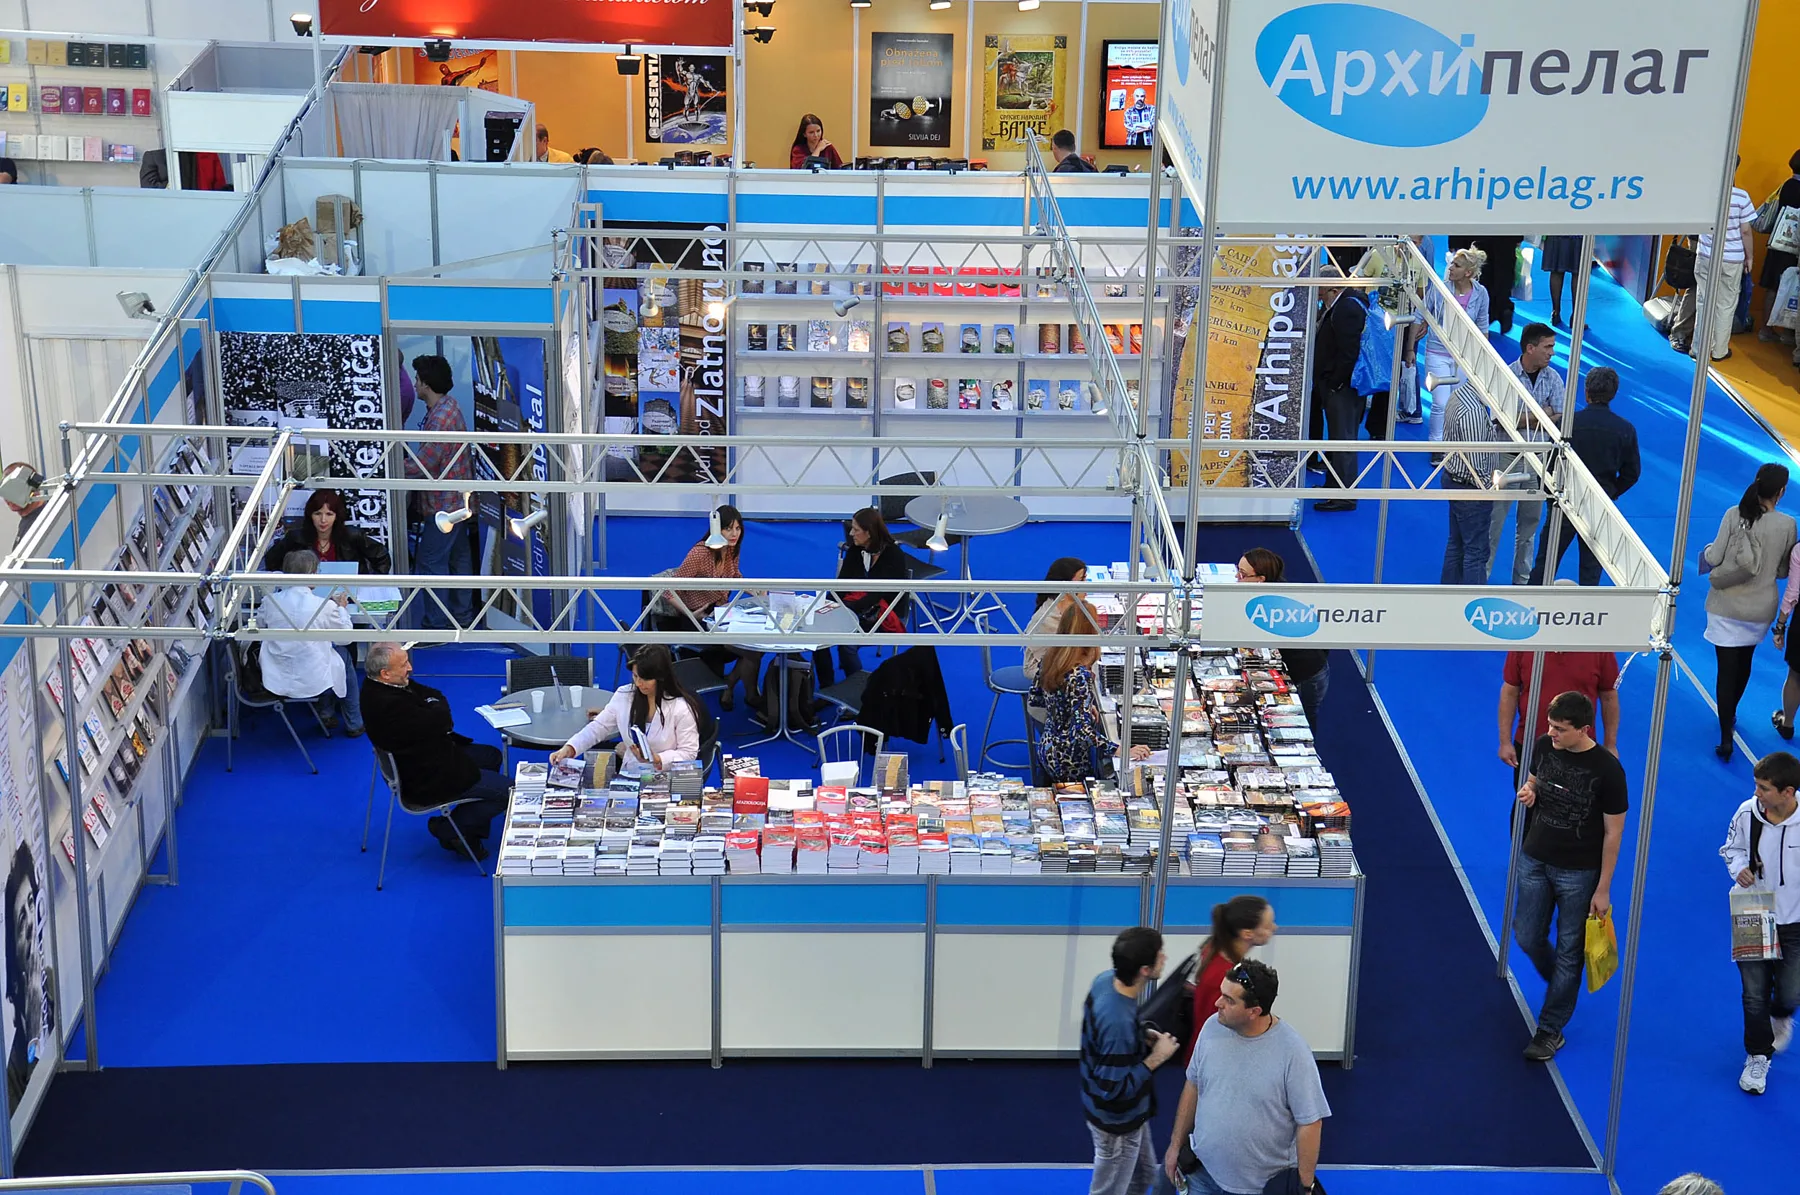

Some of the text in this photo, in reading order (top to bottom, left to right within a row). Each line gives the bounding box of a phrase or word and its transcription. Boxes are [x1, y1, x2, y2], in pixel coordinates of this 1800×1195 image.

[1270, 33, 1709, 115] Архипелаг
[908, 133, 929, 141] SILVIJA
[1292, 166, 1644, 209] www.arhipelag.rs
[1230, 301, 1244, 313] km
[1208, 316, 1261, 337] ERUSALEM
[1223, 334, 1238, 346] km
[341, 338, 384, 420] priča
[1185, 377, 1238, 392] ISANBUL
[1211, 396, 1226, 405] km
[1203, 410, 1216, 434] PET
[1218, 410, 1232, 458] GDINA
[526, 384, 547, 506] Kaptal
[1180, 460, 1235, 473] BAPES
[1250, 604, 1387, 633] Архипелаг
[1470, 606, 1609, 635] Архипелаг
